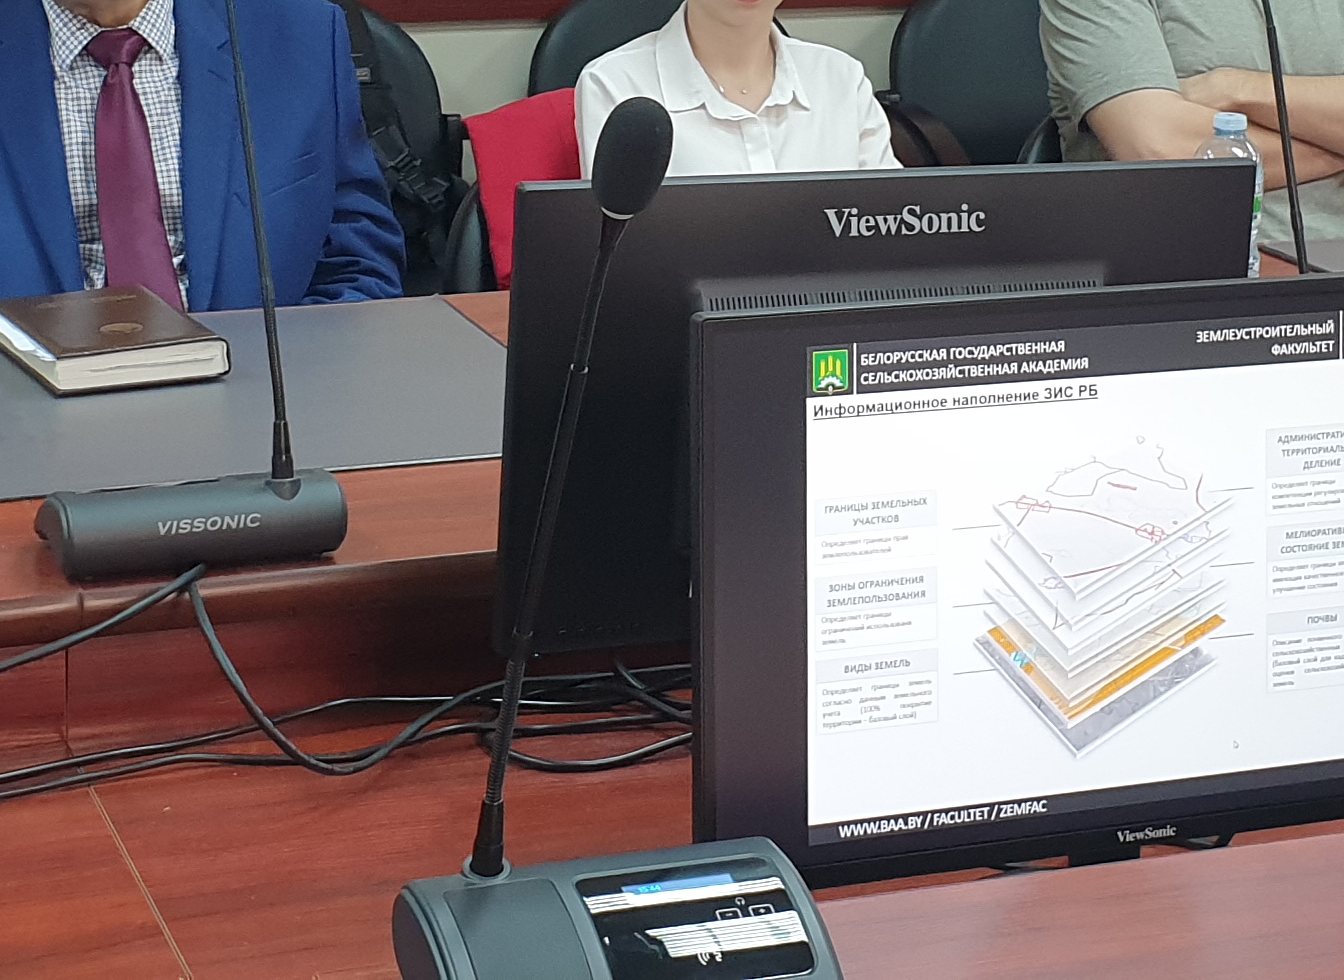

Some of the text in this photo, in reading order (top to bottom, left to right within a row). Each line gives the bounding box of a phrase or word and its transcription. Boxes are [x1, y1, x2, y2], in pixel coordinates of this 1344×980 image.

[824, 204, 985, 238] ViewSonic
[1196, 320, 1335, 343] ЗЕМЛЕУСТРОИТЕЛЬНЫЙ
[860, 341, 1065, 366] БЕЛОРУССКАЯ ГОСУДАРСТВЕННАЯ
[1271, 340, 1335, 356] ФАКУЛЬТЕТ
[860, 357, 1089, 385] СЕЛЬСКОХОЗЯЙСТВЕННАЯ АКАДЕМИЯ
[813, 385, 1098, 418] Информационное наполнение ЗИС РБ
[1303, 458, 1341, 471] ДЕЛЕНИЕ
[824, 498, 927, 514] ГРАНИЦЫ ЗЕМЕЛЬНЫХ
[157, 513, 261, 535] VISSONIC
[853, 515, 899, 526] УЧАСТКОВ
[1280, 541, 1329, 554] СОСТОЯНИЕ
[829, 575, 924, 593] ЗОНЫ ОГРАНИЧЕНИЯ
[827, 590, 926, 607] ЗЕМЛЕПОЛЬЗОВАНИЯ
[1307, 614, 1338, 624] ПОЧВЫ
[844, 659, 910, 674] ВИДЫ ЗЕМЕЛЬ
[839, 815, 923, 838] WWW.BAA.BY
[933, 806, 990, 826] FACULTET
[1000, 800, 1048, 817] ZEMFAC
[1117, 824, 1177, 843] ViewSonic
